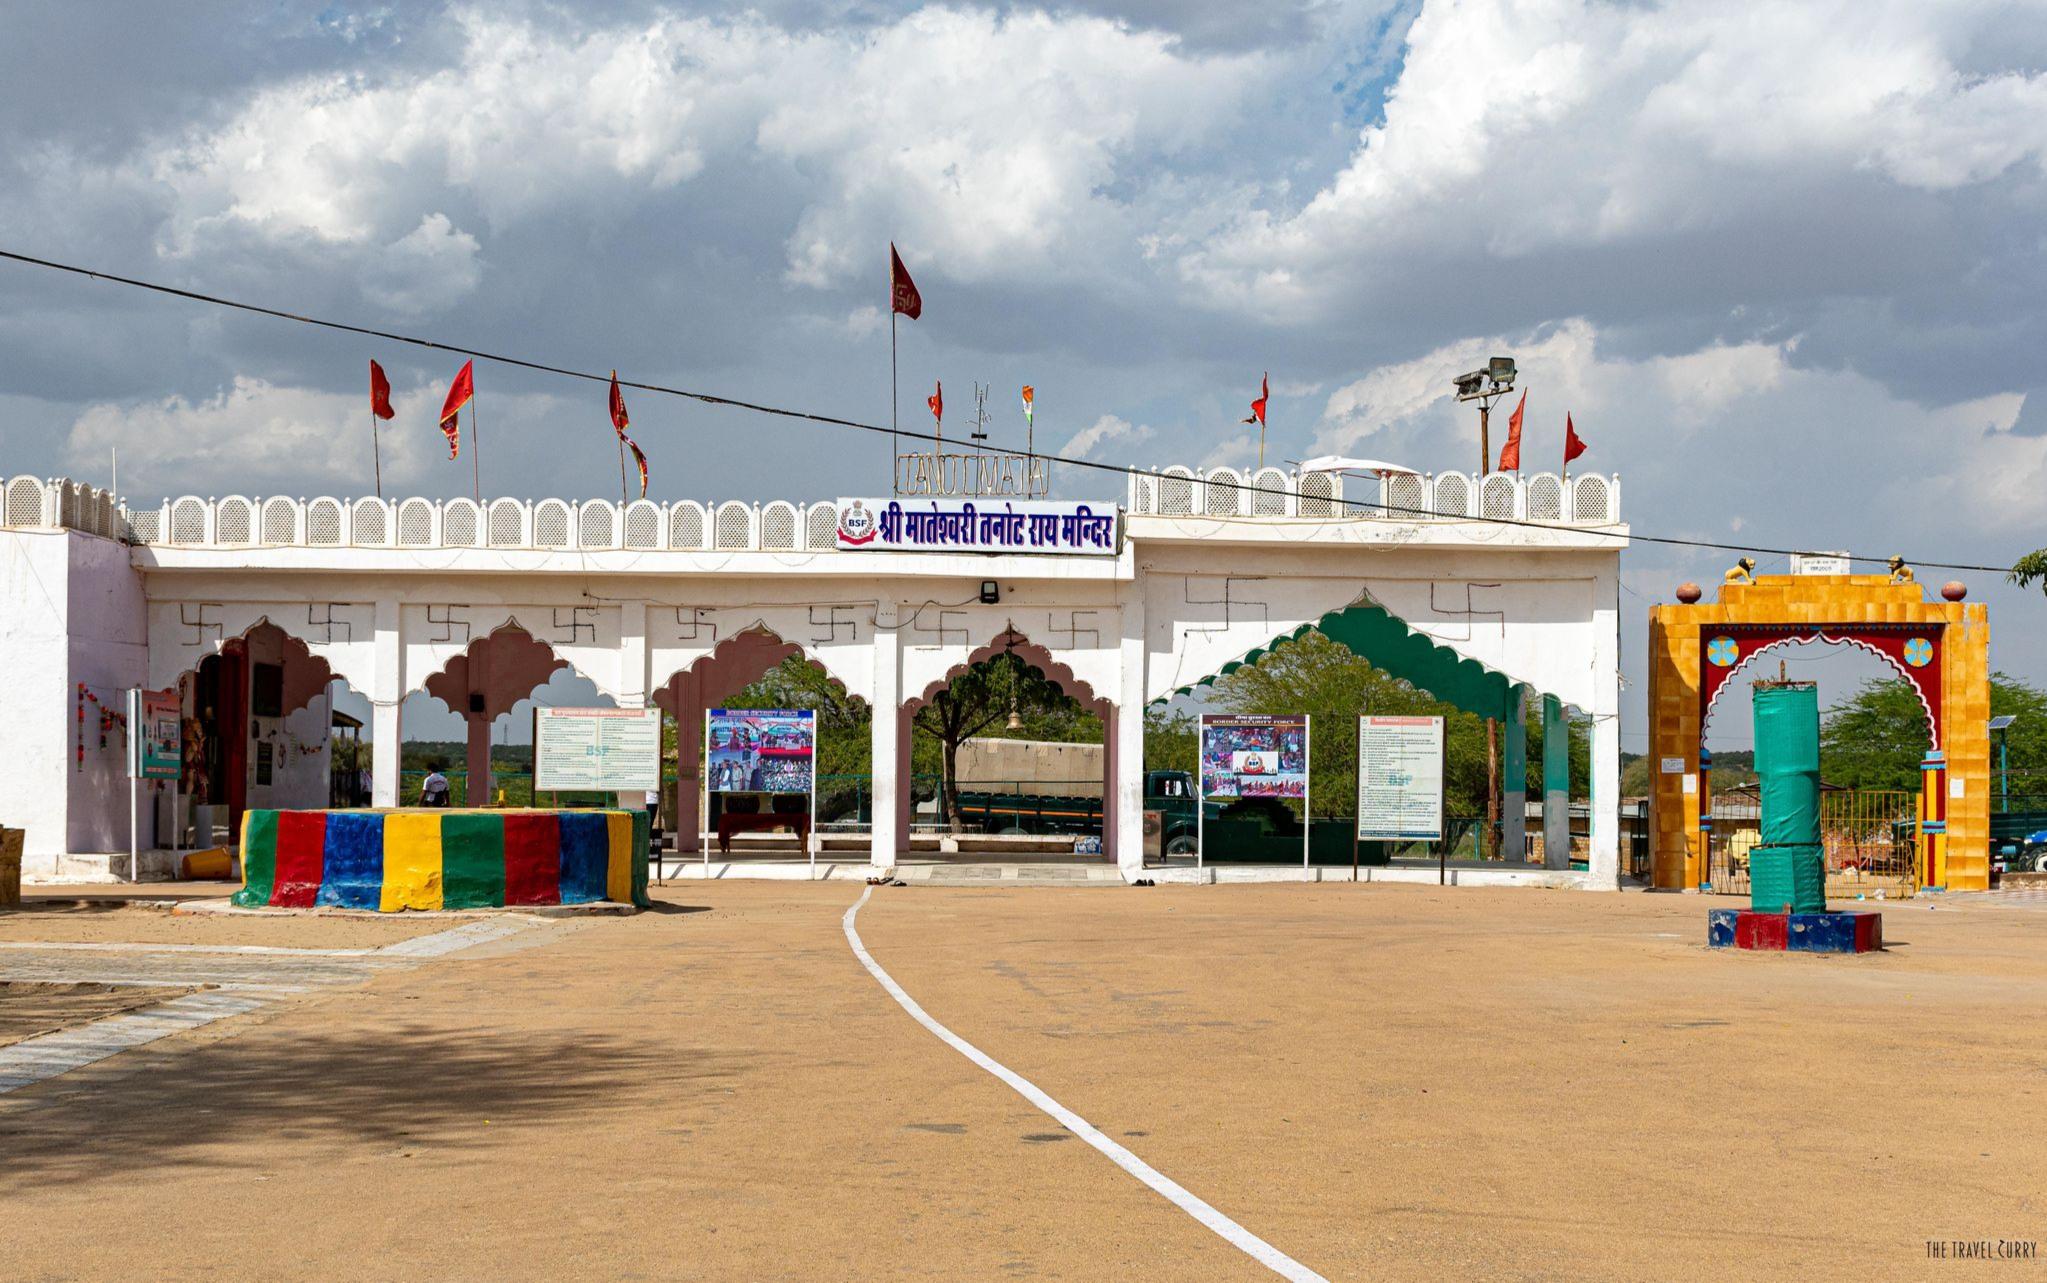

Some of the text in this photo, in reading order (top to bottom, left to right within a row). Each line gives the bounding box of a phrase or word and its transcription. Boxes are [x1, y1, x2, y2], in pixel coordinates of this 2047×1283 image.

[848, 519, 867, 528] BSF
[879, 501, 1113, 548] श्री मातेश्वरी तनोट राय मन्दिर
